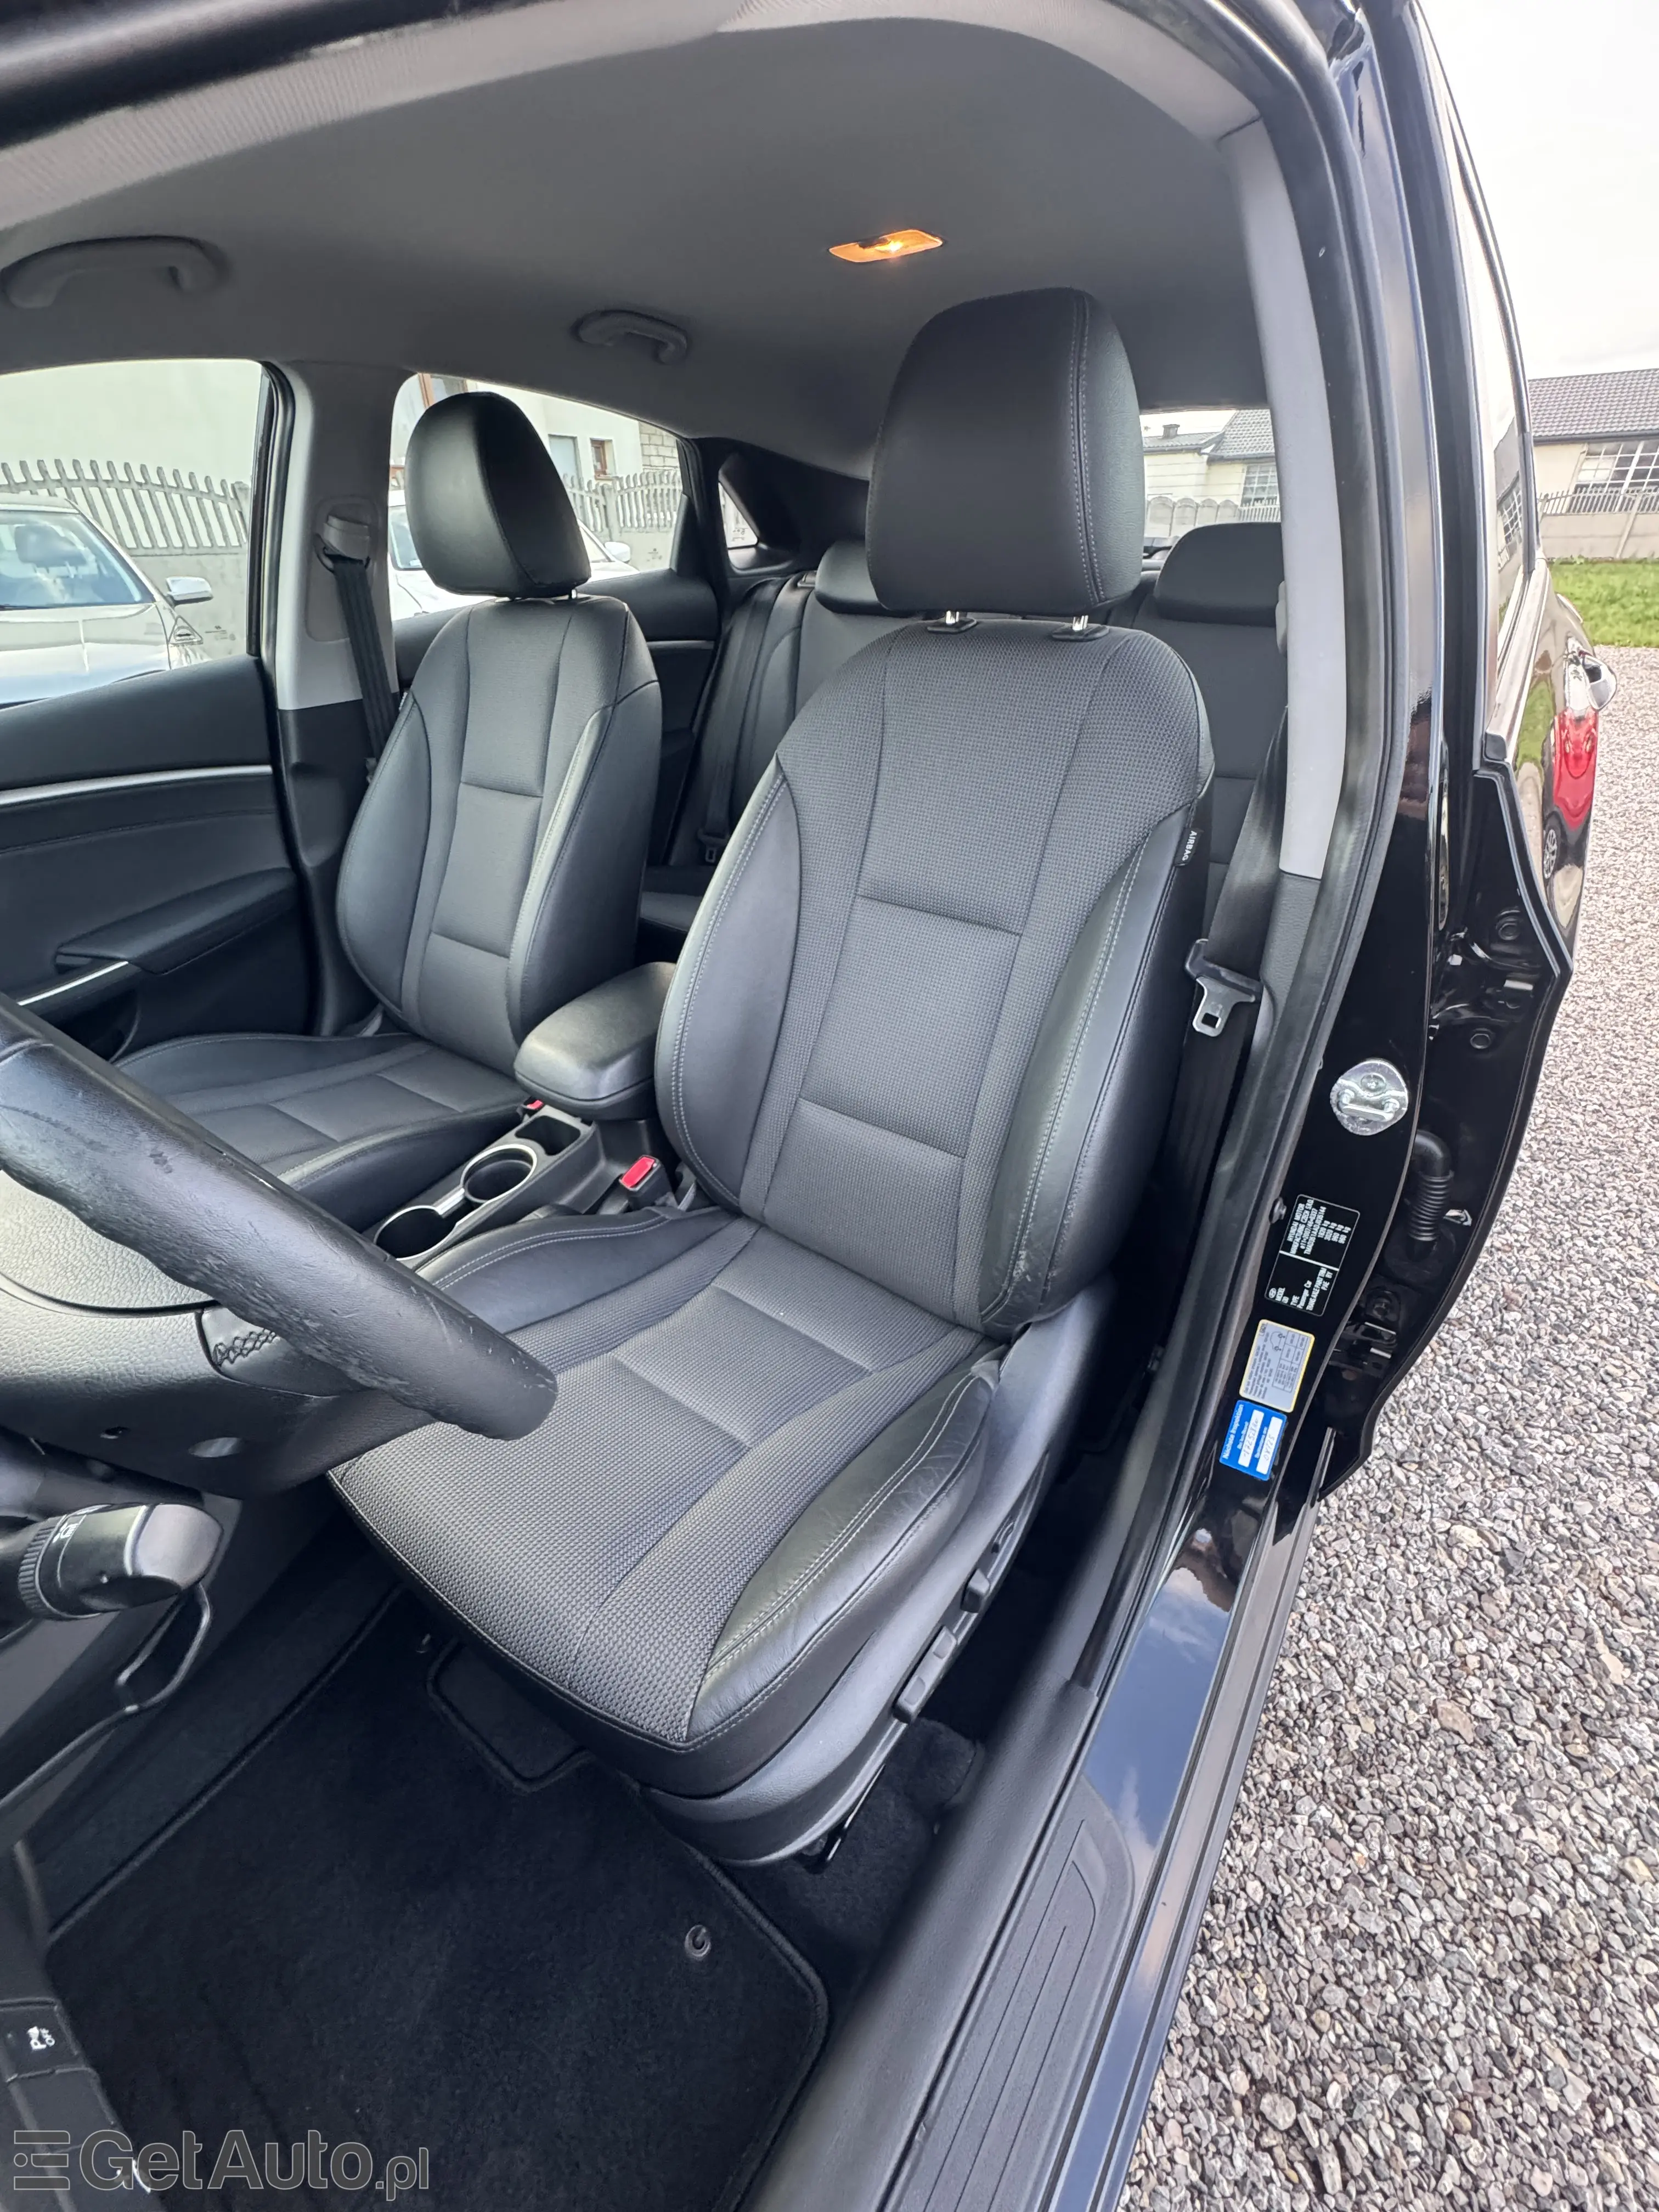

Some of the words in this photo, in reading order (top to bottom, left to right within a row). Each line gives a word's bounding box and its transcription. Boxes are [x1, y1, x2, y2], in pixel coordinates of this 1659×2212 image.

[1182, 830, 1197, 861] AIRBAG
[1287, 1221, 1299, 1242] HYUNDAI
[1294, 1203, 1305, 1220] MOTOR
[1290, 1295, 1299, 1306] TYPE
